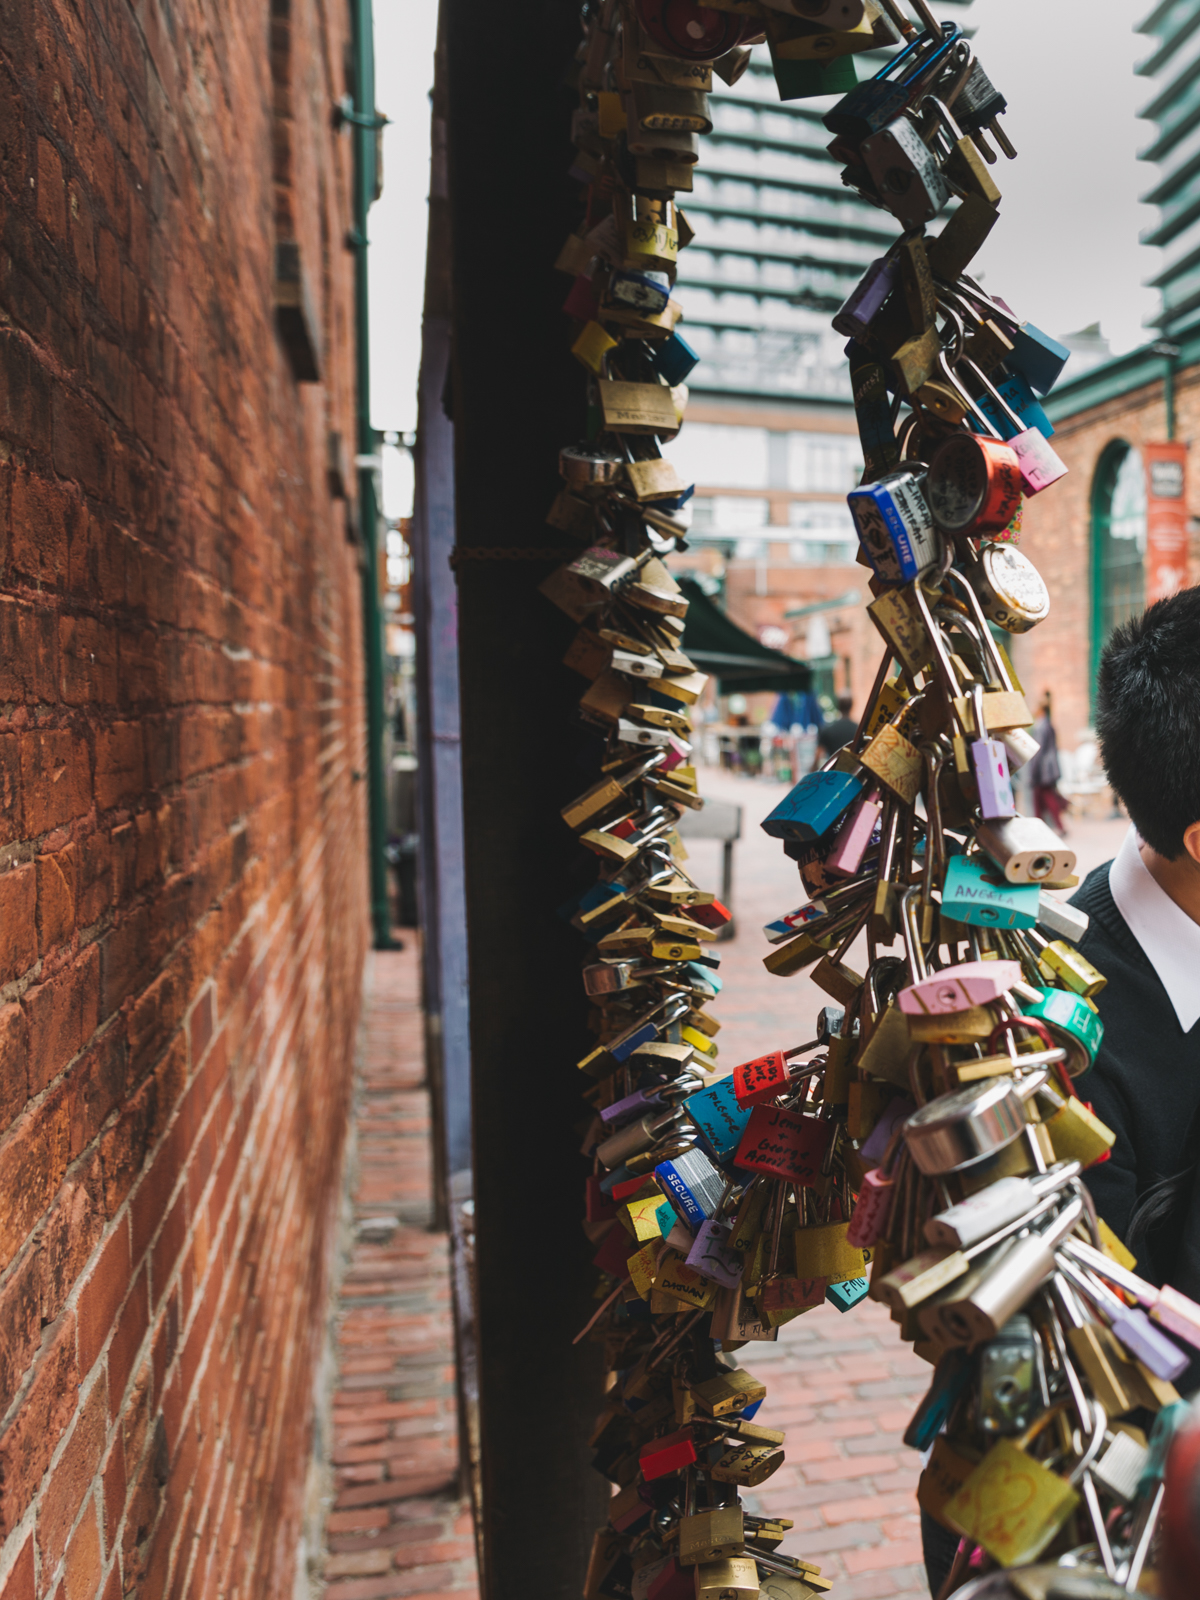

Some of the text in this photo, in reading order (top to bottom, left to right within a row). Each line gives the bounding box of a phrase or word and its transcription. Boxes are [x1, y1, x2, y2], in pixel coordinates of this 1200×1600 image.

[884, 506, 913, 564] SECURE
[768, 1112, 802, 1134] Jenn
[744, 1149, 785, 1167] April
[757, 1138, 809, 1160] George
[667, 1173, 699, 1214] SECURE
[661, 1279, 705, 1300] DAJUAN
[719, 1446, 747, 1469] Rob
